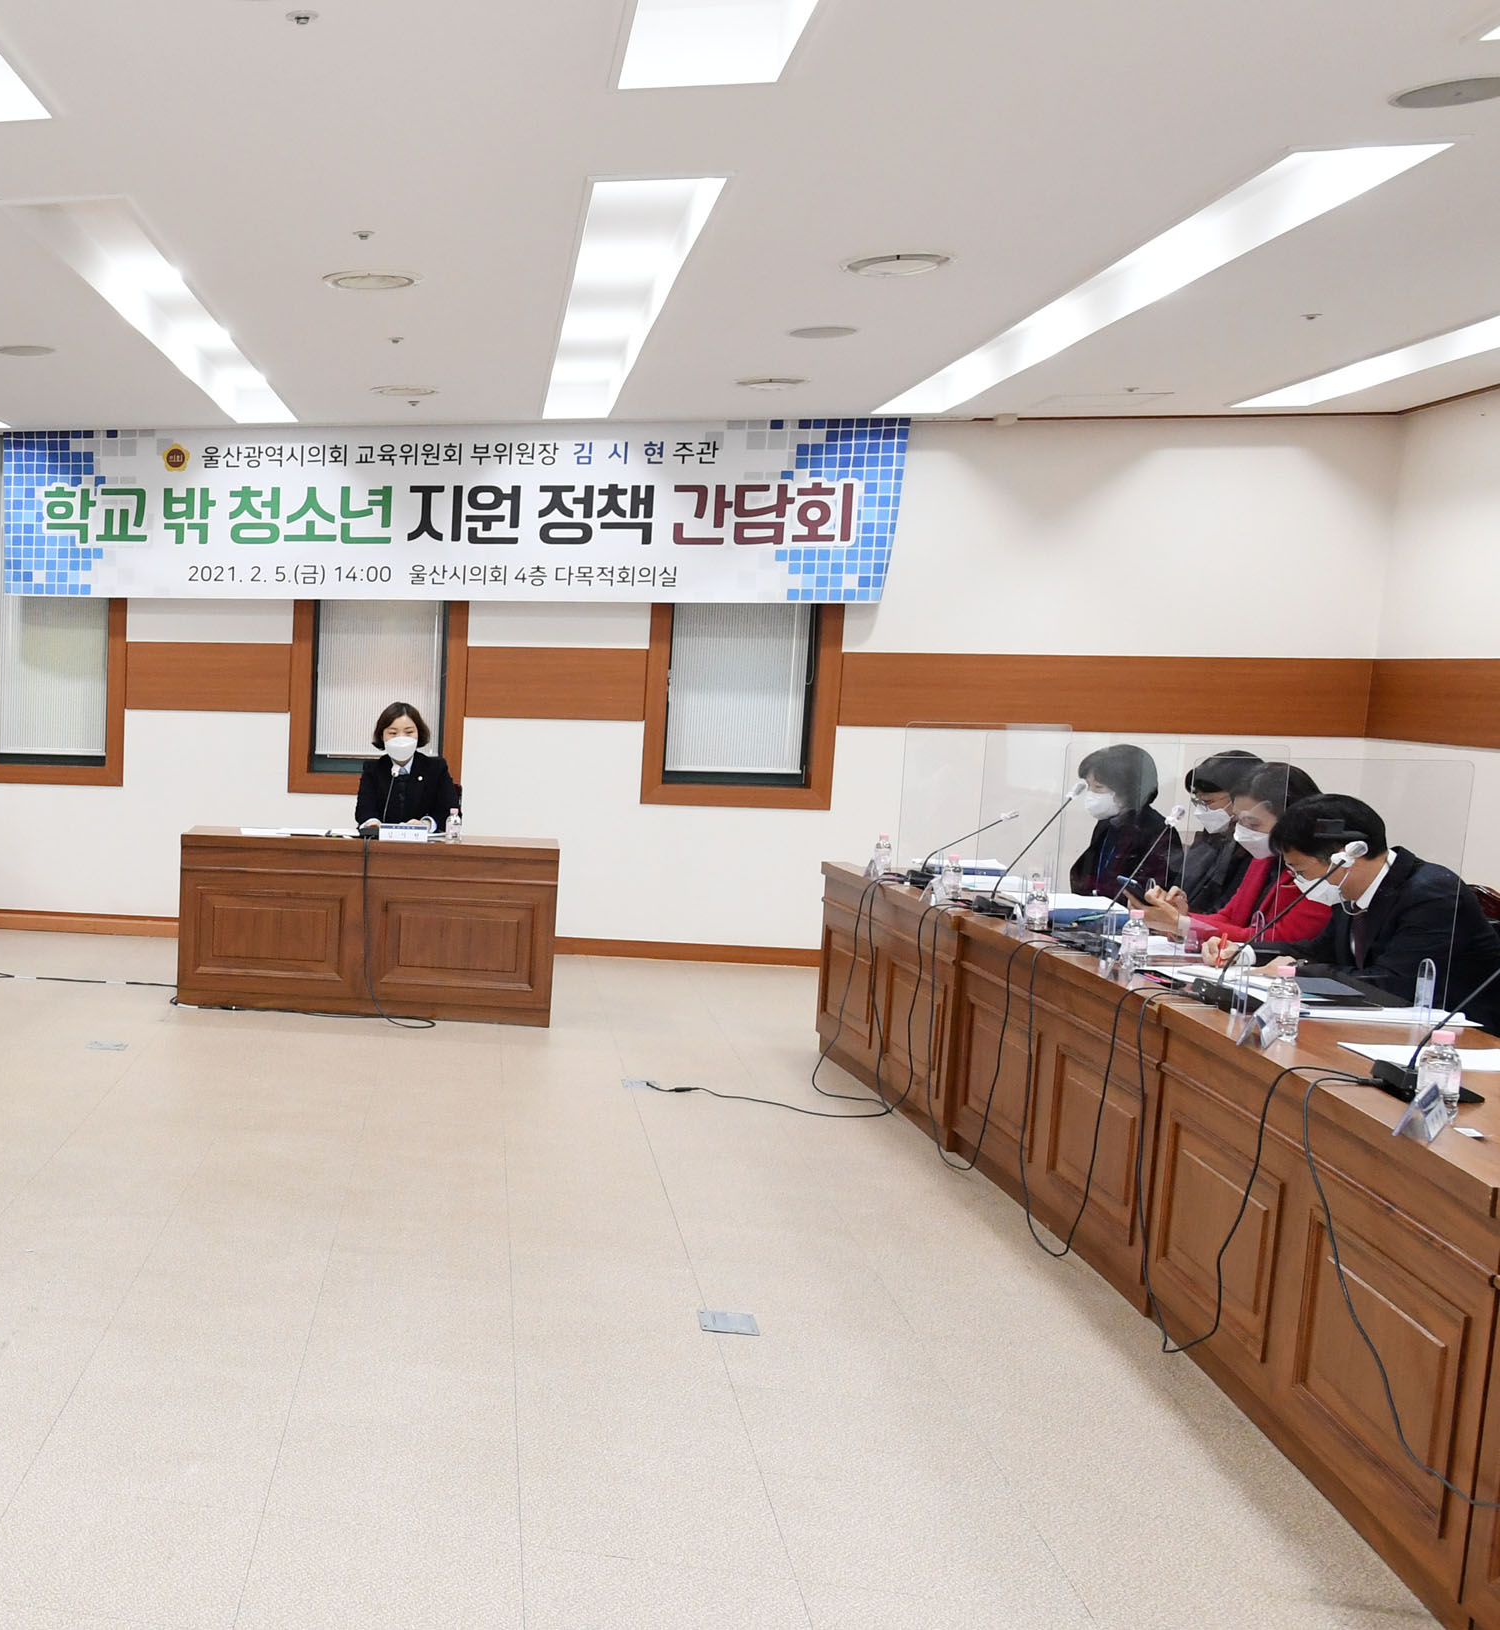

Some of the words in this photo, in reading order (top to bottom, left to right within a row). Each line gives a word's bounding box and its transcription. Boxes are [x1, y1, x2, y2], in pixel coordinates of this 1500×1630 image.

[201, 444, 348, 469] 울산광역시의회
[355, 443, 463, 467] 교육위원회
[470, 442, 560, 466] 부위원장
[573, 441, 593, 465] 김
[608, 441, 629, 464] 시
[644, 441, 664, 464] 현
[672, 441, 719, 464] 주관
[44, 486, 148, 544] 학교
[163, 487, 216, 544] 밖
[229, 485, 393, 545] 청소년
[407, 485, 521, 544] 지원
[538, 484, 655, 545] 정책
[673, 482, 854, 545] 간담회
[188, 565, 243, 583] 2021.
[250, 565, 267, 583] 2.
[334, 565, 392, 582] 14:00
[408, 564, 508, 586] 울산시의회
[514, 565, 548, 586] 4층
[555, 565, 678, 587] 다목적회의실
